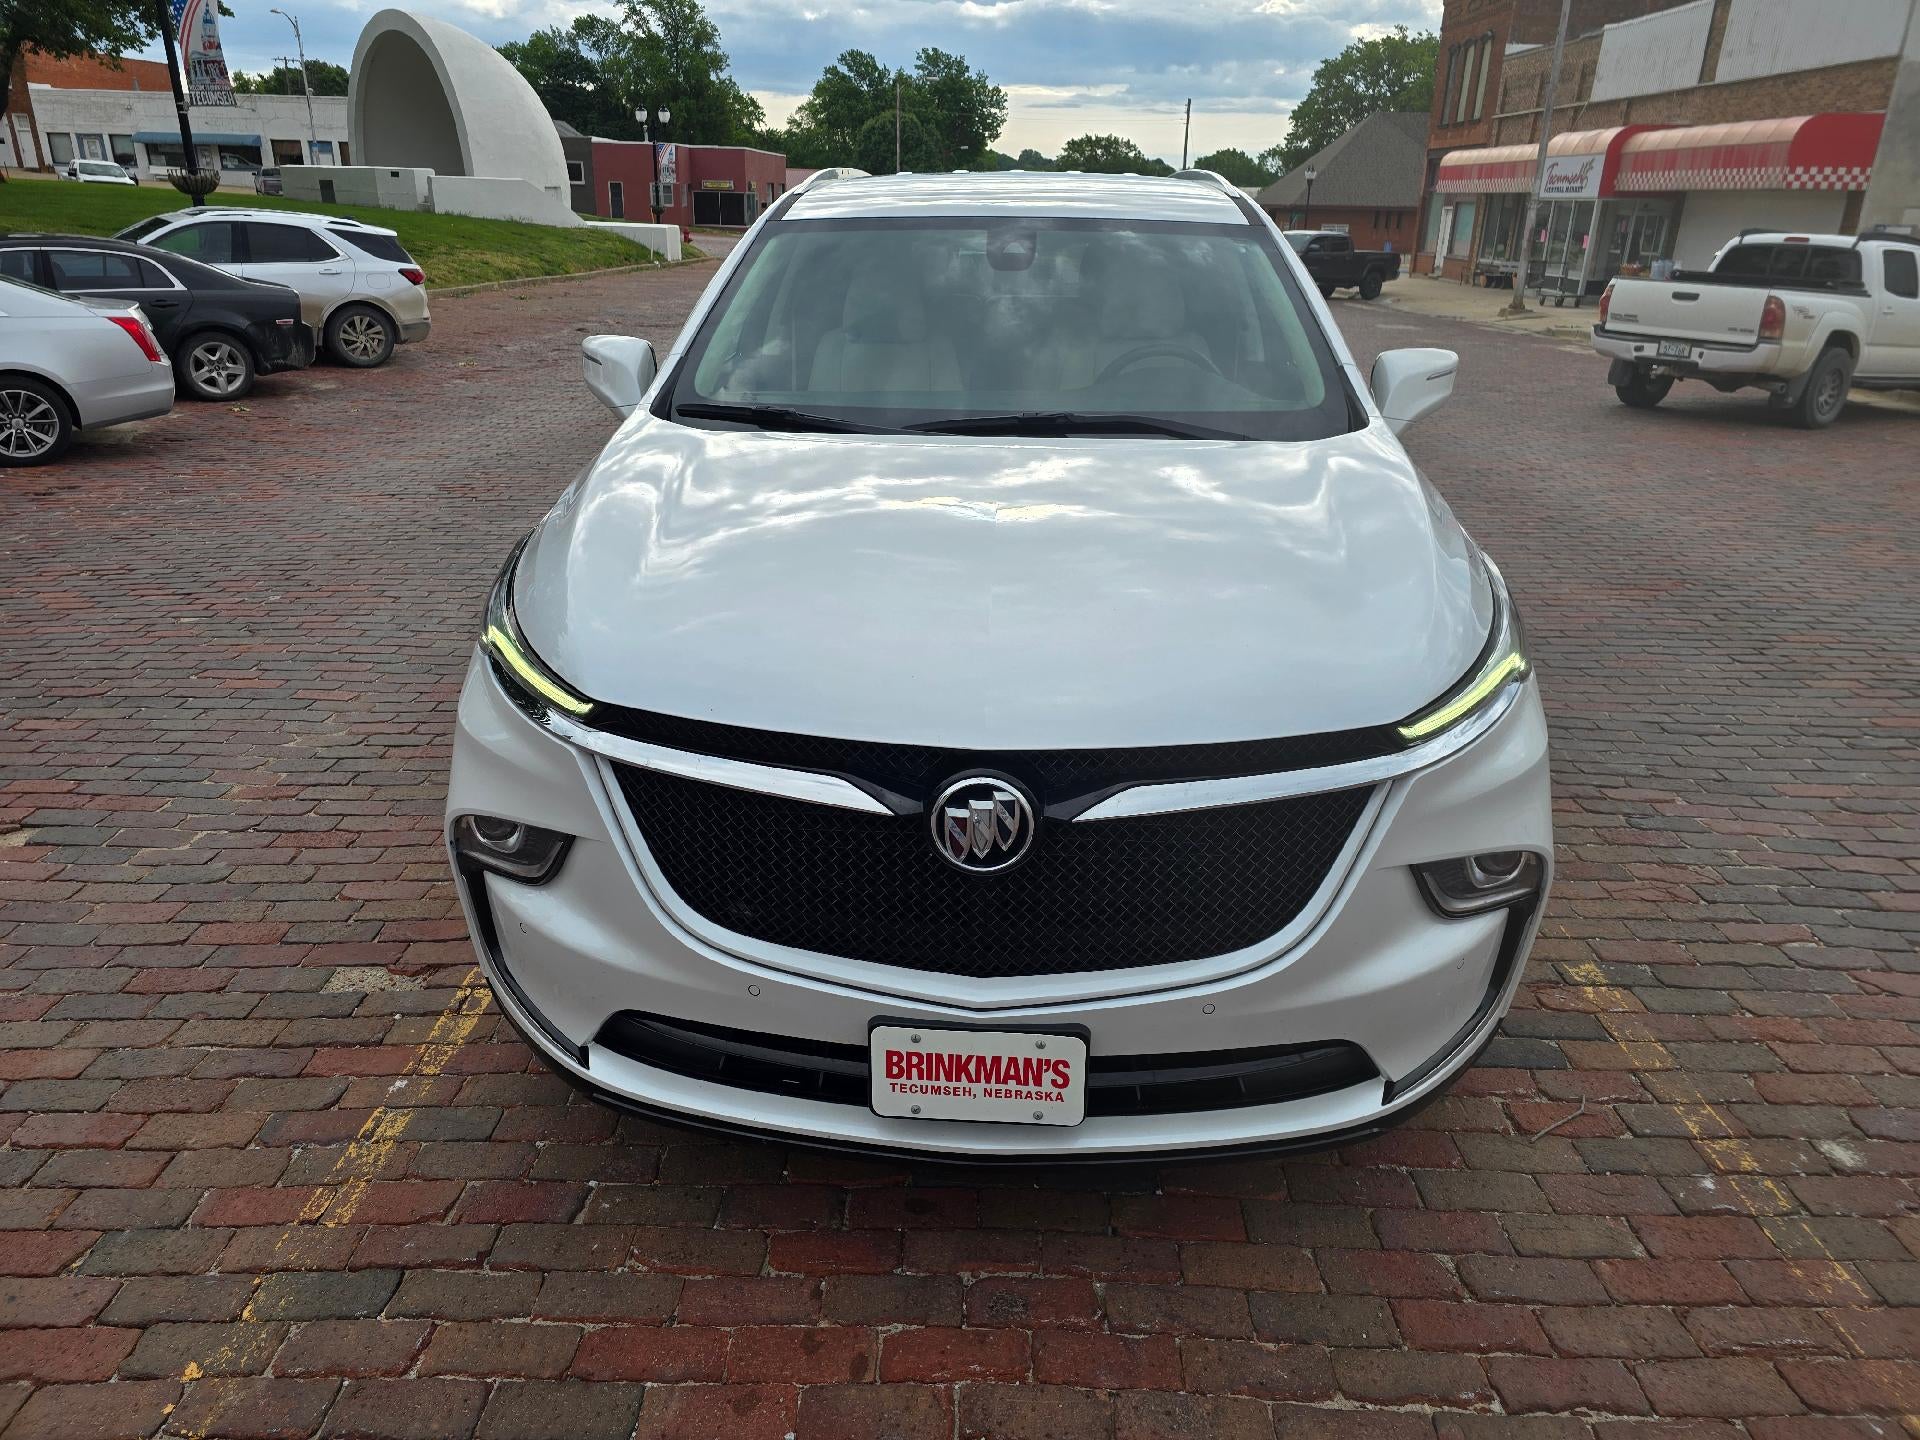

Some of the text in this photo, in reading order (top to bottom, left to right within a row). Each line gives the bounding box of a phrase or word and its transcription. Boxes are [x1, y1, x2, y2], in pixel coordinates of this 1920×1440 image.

[190, 90, 235, 105] TECUMSEH
[885, 1049, 1070, 1089] BRINKMAN'S
[889, 1082, 1065, 1102] TECUMSEH, NEBRASKA
